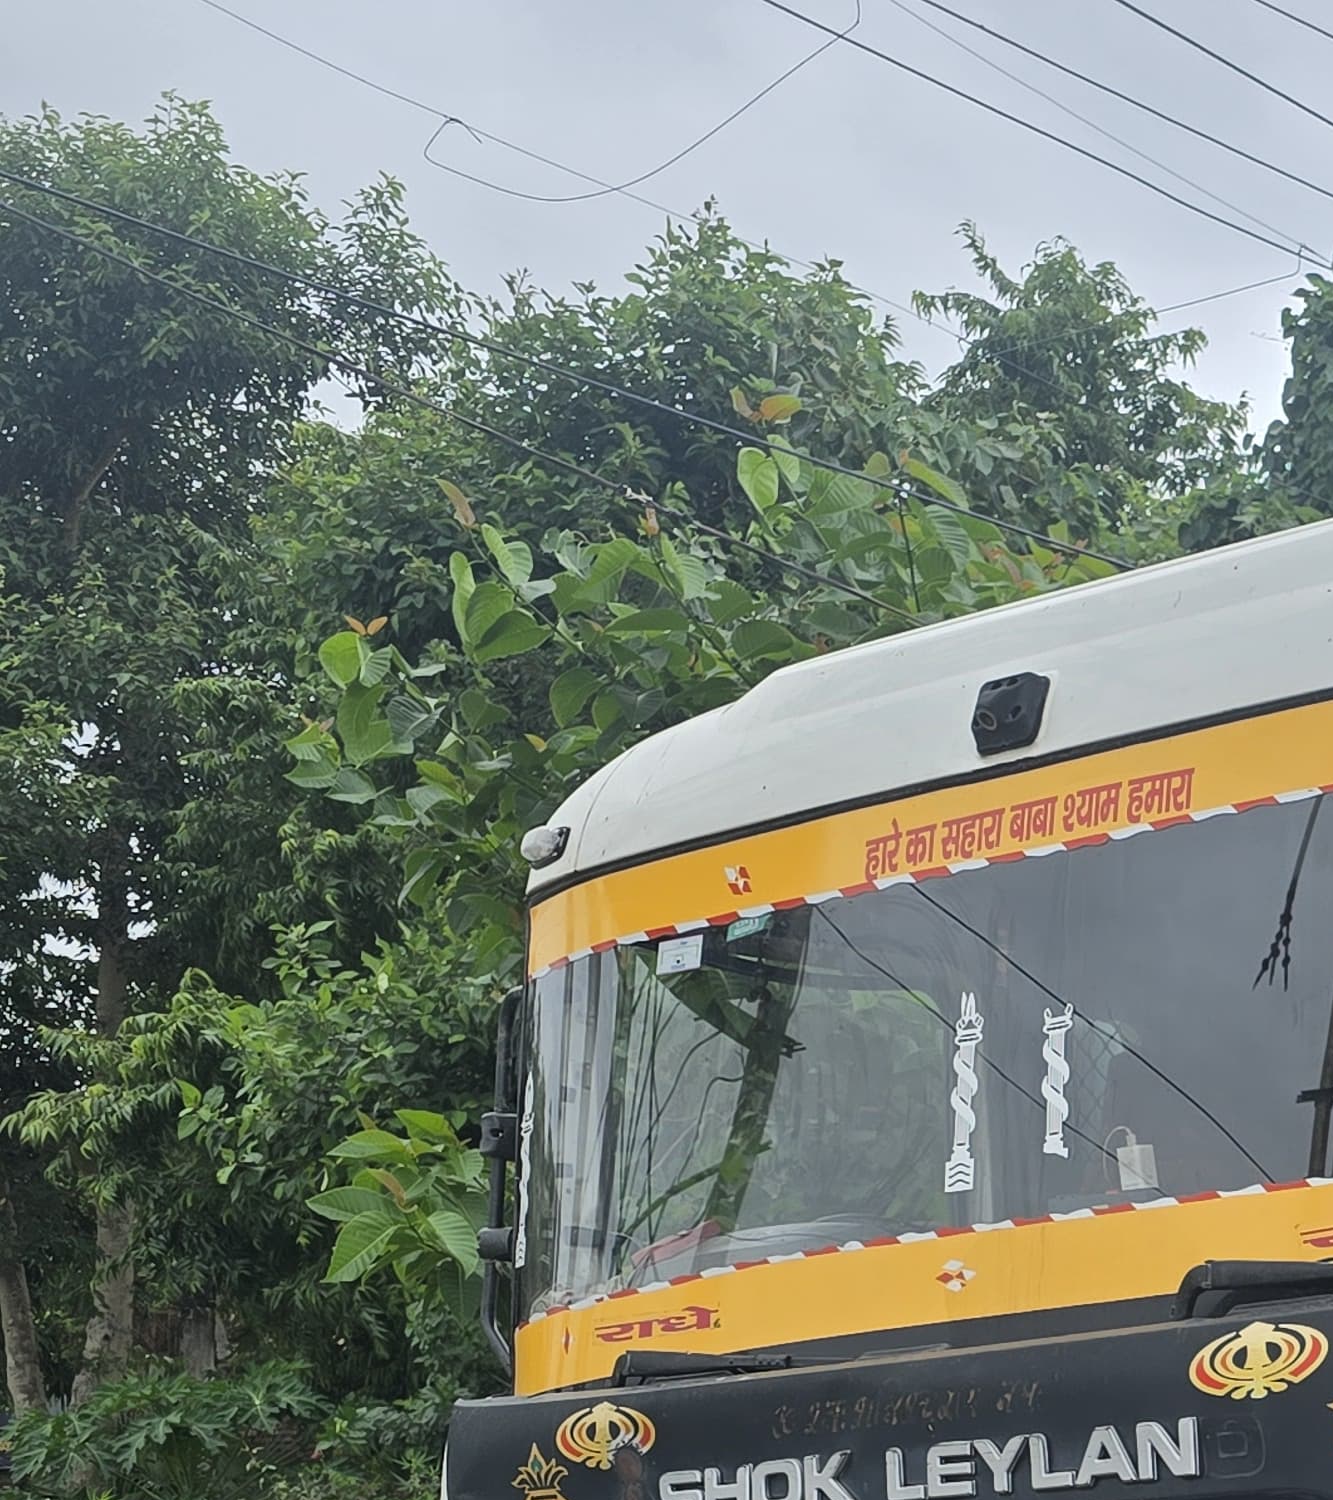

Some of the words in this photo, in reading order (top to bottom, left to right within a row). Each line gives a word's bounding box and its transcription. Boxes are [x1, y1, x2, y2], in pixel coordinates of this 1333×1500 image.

[865, 818, 902, 881] हारे
[905, 824, 936, 866] का
[941, 808, 1005, 860] सहारा
[1009, 796, 1057, 843] बाबा
[1062, 782, 1122, 832] श्याम
[1127, 768, 1195, 823] हमारा
[594, 1305, 719, 1342] राधे
